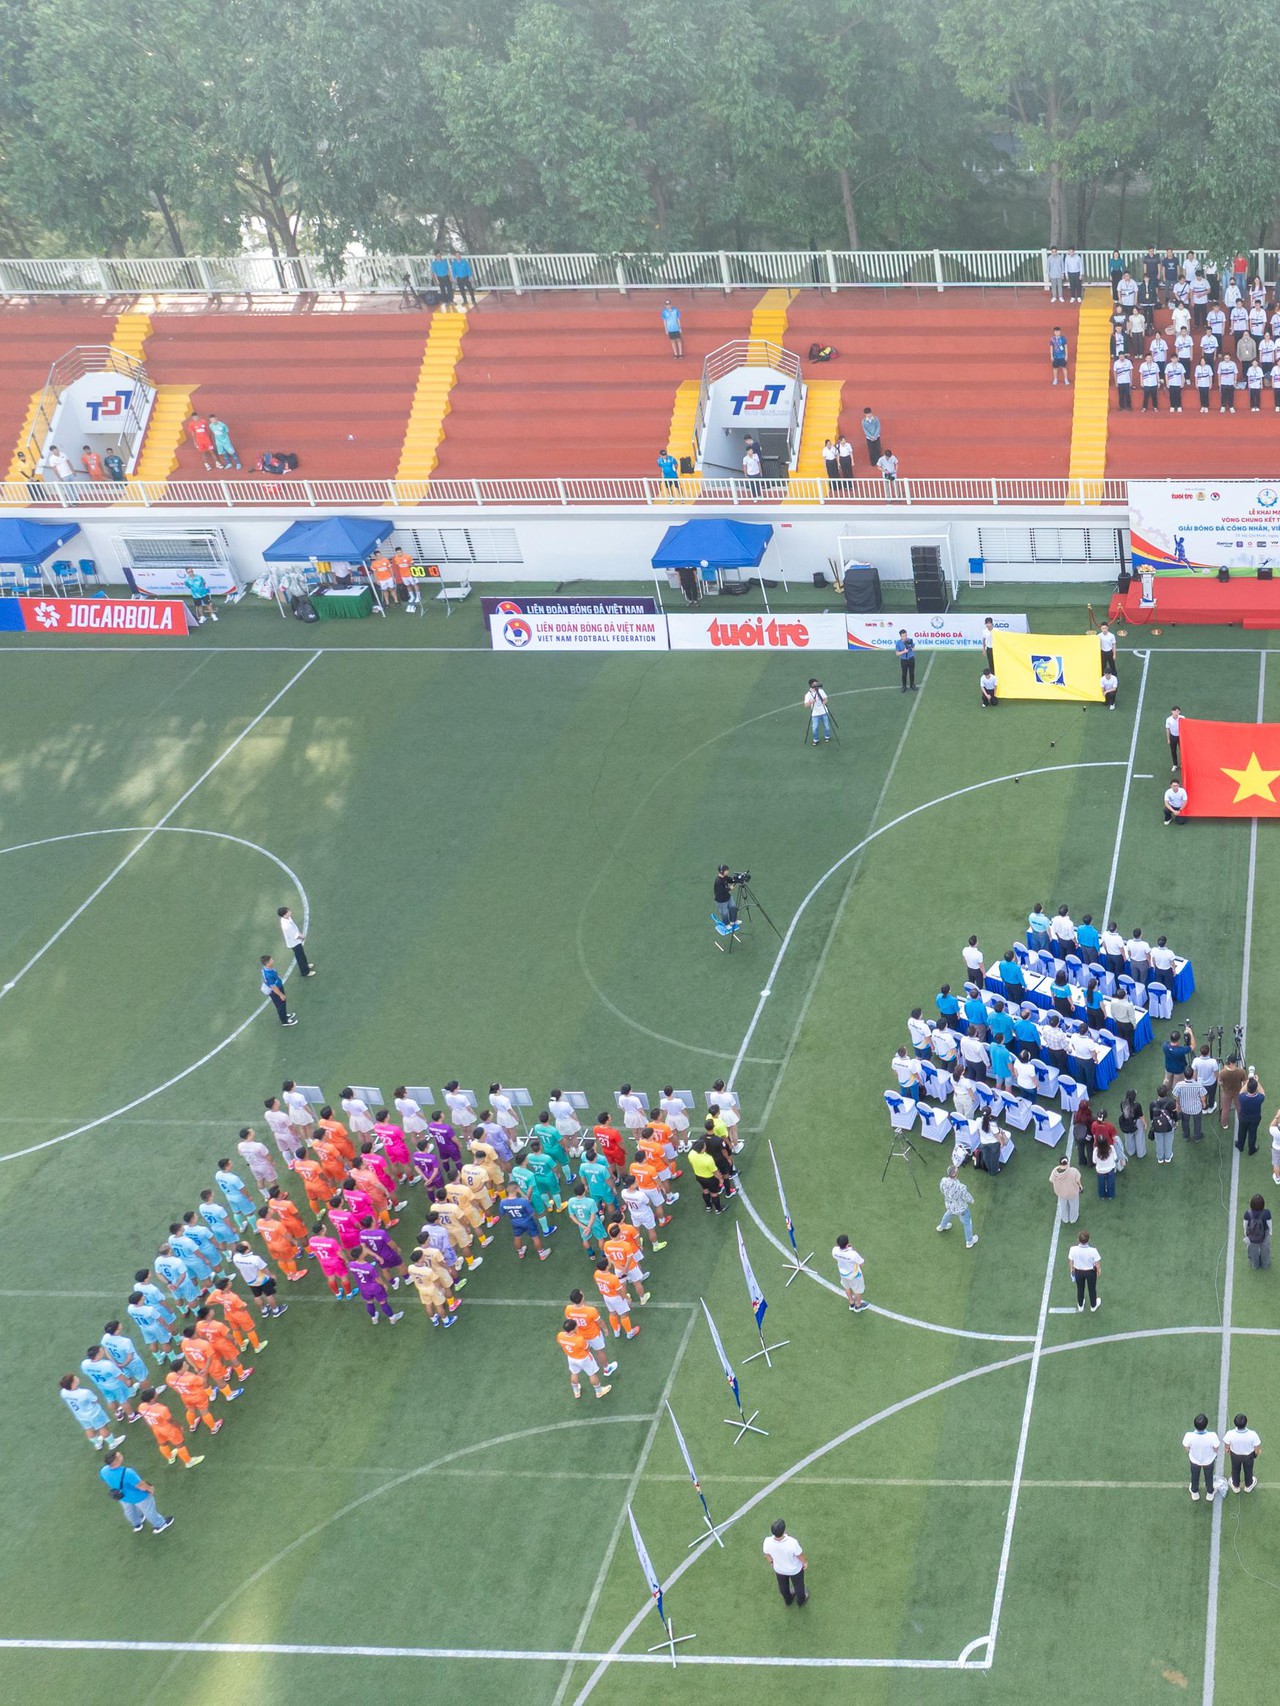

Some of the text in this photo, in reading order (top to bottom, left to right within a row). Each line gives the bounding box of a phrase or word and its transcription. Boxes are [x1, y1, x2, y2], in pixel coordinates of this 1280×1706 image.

[730, 384, 786, 416] TDT
[1249, 524, 1269, 532] NHÂN,
[526, 602, 544, 614] LIÊN
[546, 602, 568, 614] ĐOÀN
[570, 602, 592, 614] BÓNG
[593, 602, 606, 614] ĐÁ
[625, 605, 644, 614] NAM
[66, 604, 172, 630] JOGARBOLA
[536, 622, 655, 635] LIÊN ĐOÀN BÓNG ĐÁ VIỆT NAM
[706, 616, 809, 647] tuổi trẻ
[914, 630, 963, 638] GIẢI BÓNG ĐÁ
[957, 638, 971, 646] VIỆT
[534, 1166, 545, 1174] 22
[467, 1176, 473, 1185] 8
[590, 1174, 597, 1183] 4
[637, 1174, 643, 1182] 7
[508, 1209, 522, 1218] 15
[577, 1209, 584, 1218] 5
[440, 1216, 451, 1225] 26
[317, 1249, 329, 1259] 12
[612, 1252, 624, 1261] 10
